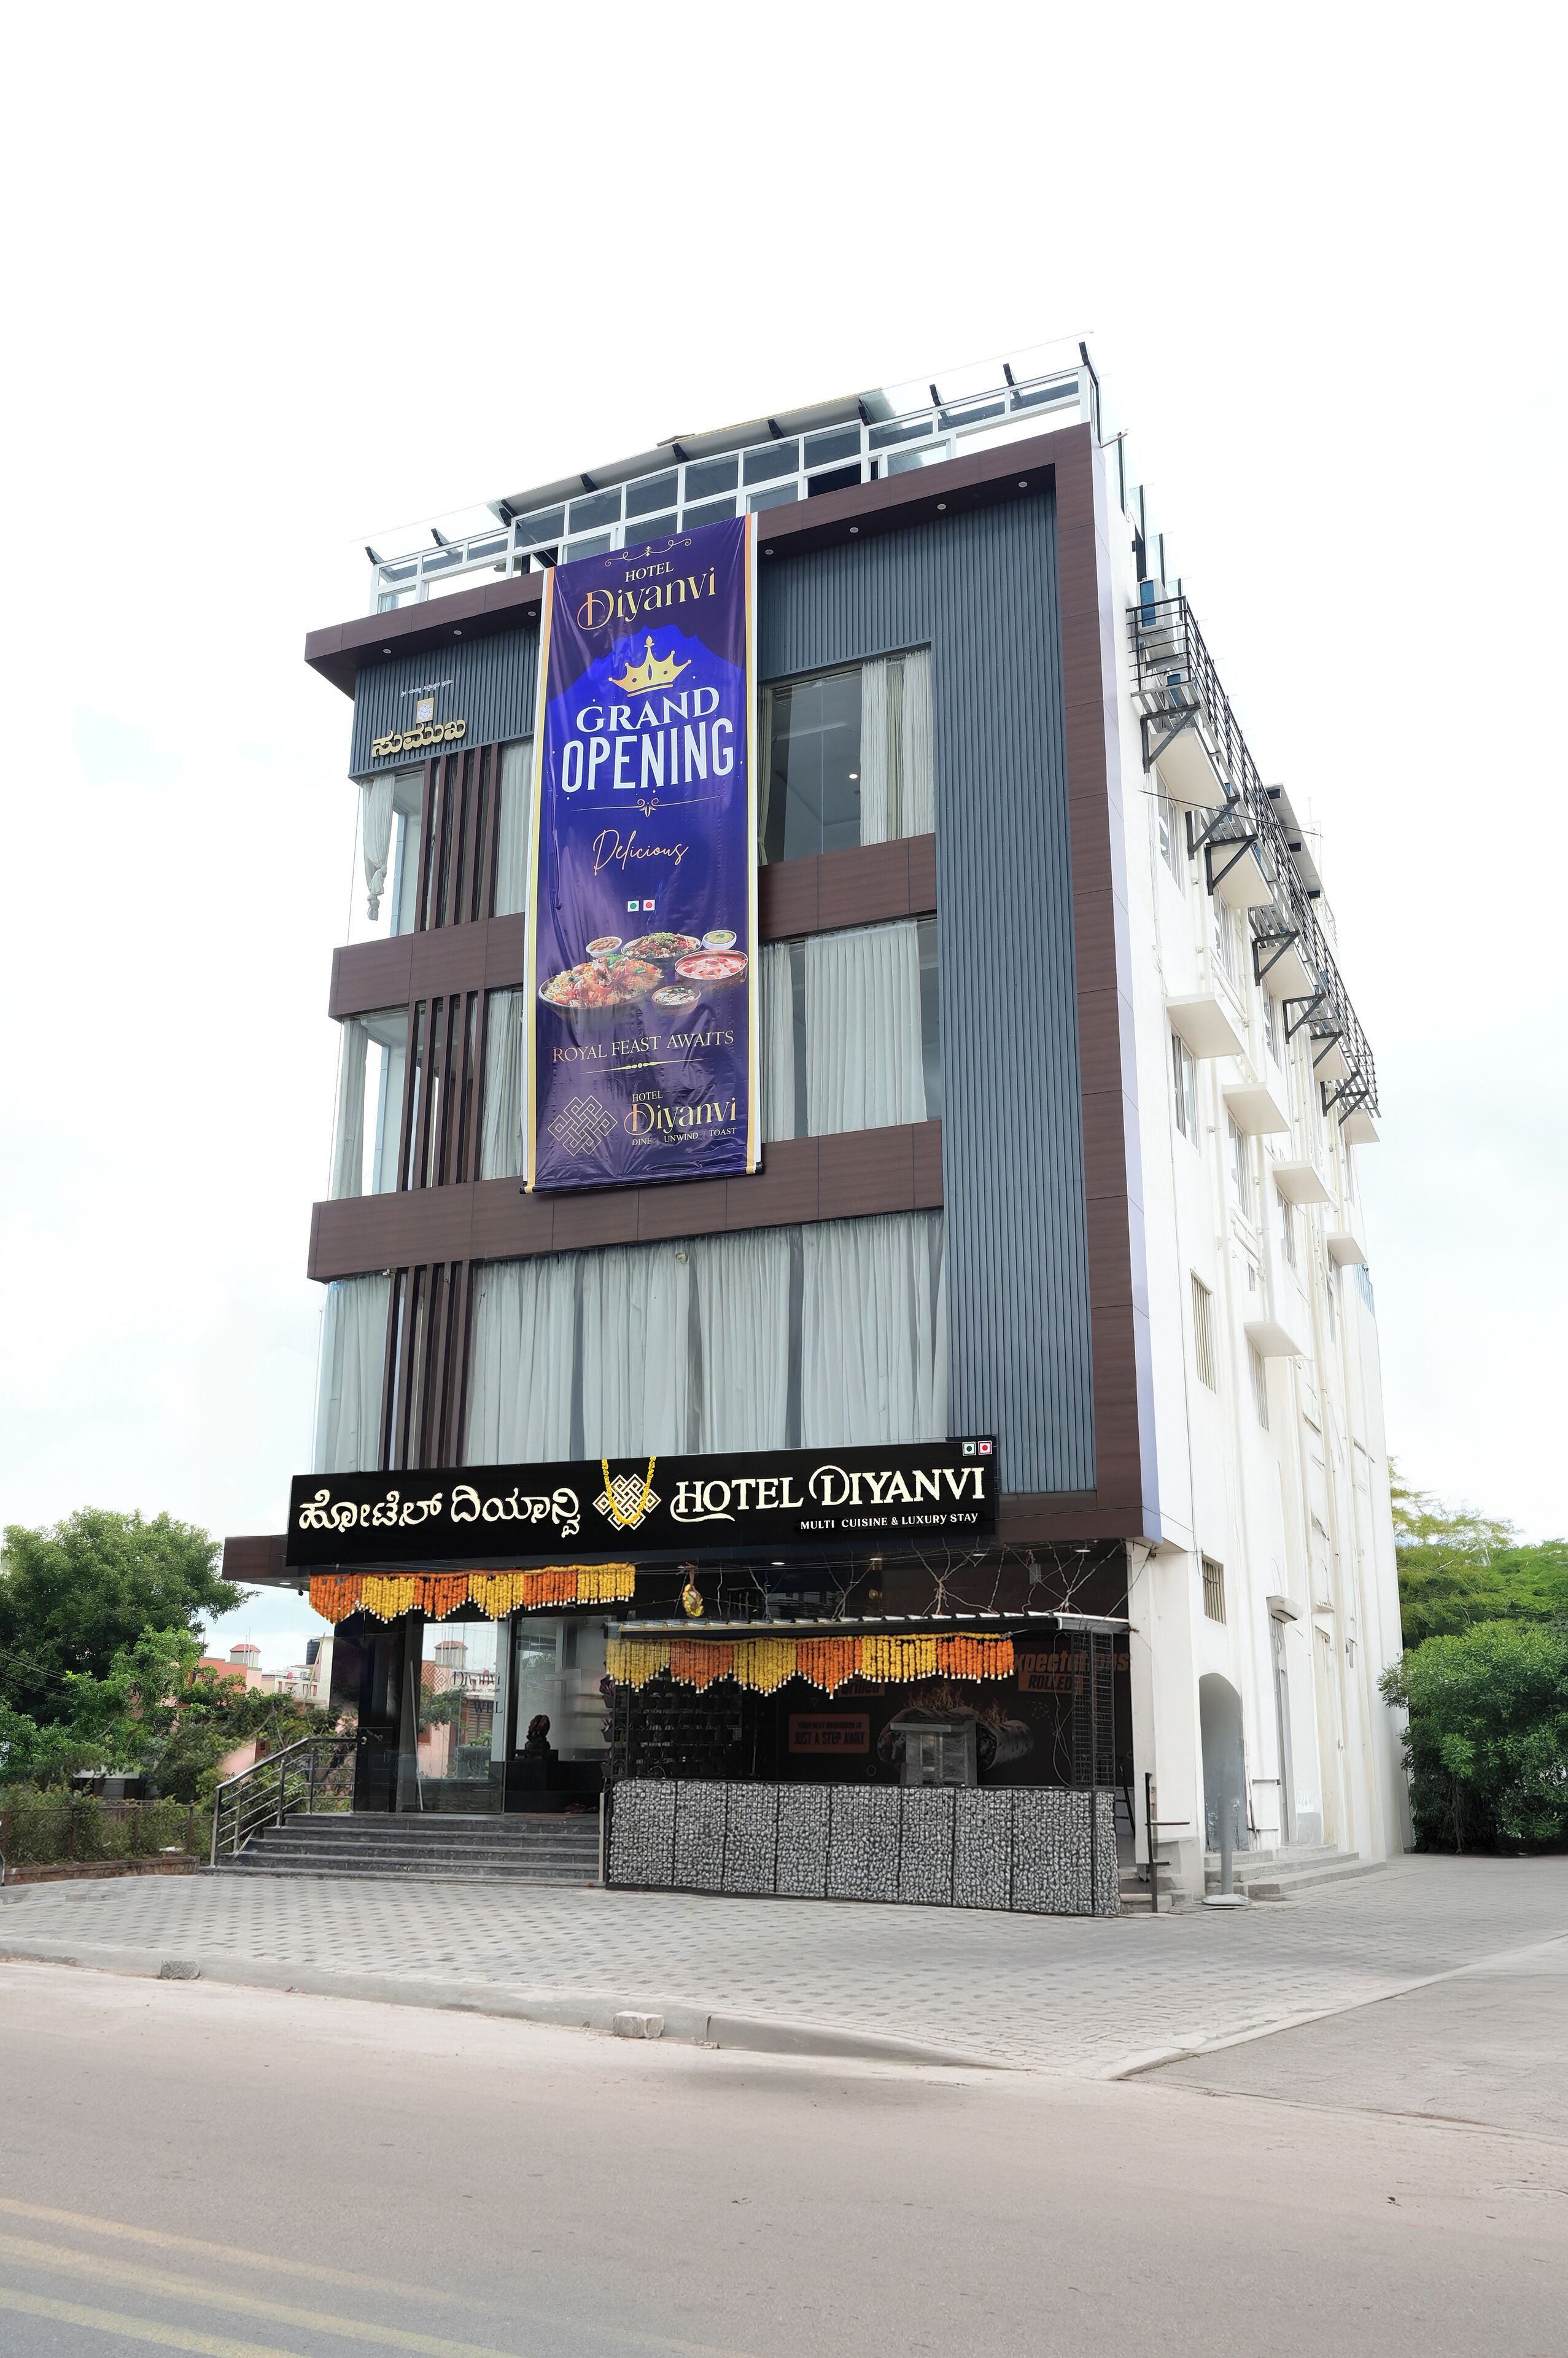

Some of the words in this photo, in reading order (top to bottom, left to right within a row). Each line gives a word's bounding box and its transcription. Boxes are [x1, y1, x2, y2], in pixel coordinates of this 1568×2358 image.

[625, 561, 673, 582] HOTEL
[577, 567, 716, 630] Diyanvi
[576, 687, 720, 733] GRAND
[371, 719, 467, 758] ಸುಮುಖ
[562, 718, 734, 793] OPENING
[593, 829, 689, 876] Delicious
[553, 1044, 608, 1062] ROYAL
[611, 1037, 662, 1056] FEAST
[666, 1030, 734, 1049] AWAITS
[632, 1091, 663, 1102] HOTEL
[624, 1097, 737, 1136] Diyanvi
[632, 1137, 652, 1146] DINE
[664, 1132, 699, 1142] UNWIND
[709, 1127, 737, 1137] TOAST
[298, 1488, 443, 1533] ಹೋಟೆಲ್
[451, 1485, 580, 1538] ದಿಯಾನ್ವಿ
[670, 1477, 804, 1522] HOTEL
[809, 1465, 985, 1506] DIYANVI
[801, 1519, 835, 1530] MULTI
[841, 1517, 888, 1528] CUISINE
[891, 1516, 899, 1525] &
[902, 1514, 947, 1526] LUXURY
[950, 1512, 979, 1523] STAY
[794, 1732, 812, 1745] JUST
[815, 1732, 820, 1745] A
[822, 1732, 842, 1745] STEP
[844, 1732, 865, 1745] AWAY
